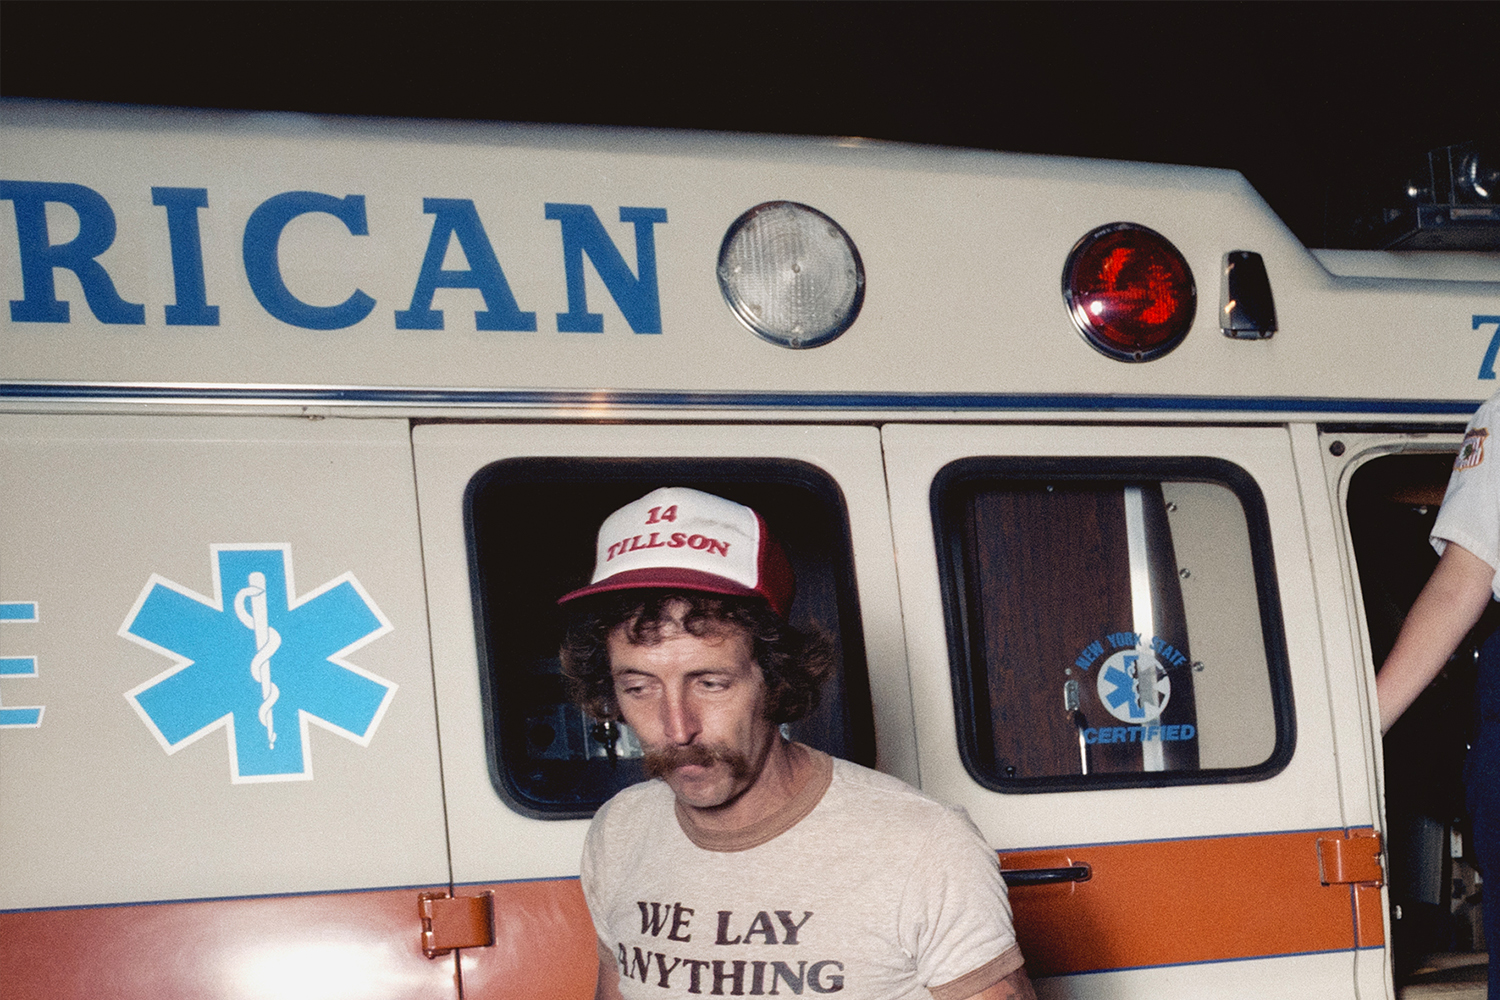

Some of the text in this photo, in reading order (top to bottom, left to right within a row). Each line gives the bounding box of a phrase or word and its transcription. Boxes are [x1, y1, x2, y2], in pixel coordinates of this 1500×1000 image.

[645, 505, 678, 524] 14
[606, 532, 731, 562] TILLSON
[1075, 632, 1187, 671] NEW YORK STATE
[1083, 724, 1196, 744] CERTIFIED
[637, 901, 814, 945] WE LAY
[618, 942, 844, 996] ANYTHING
